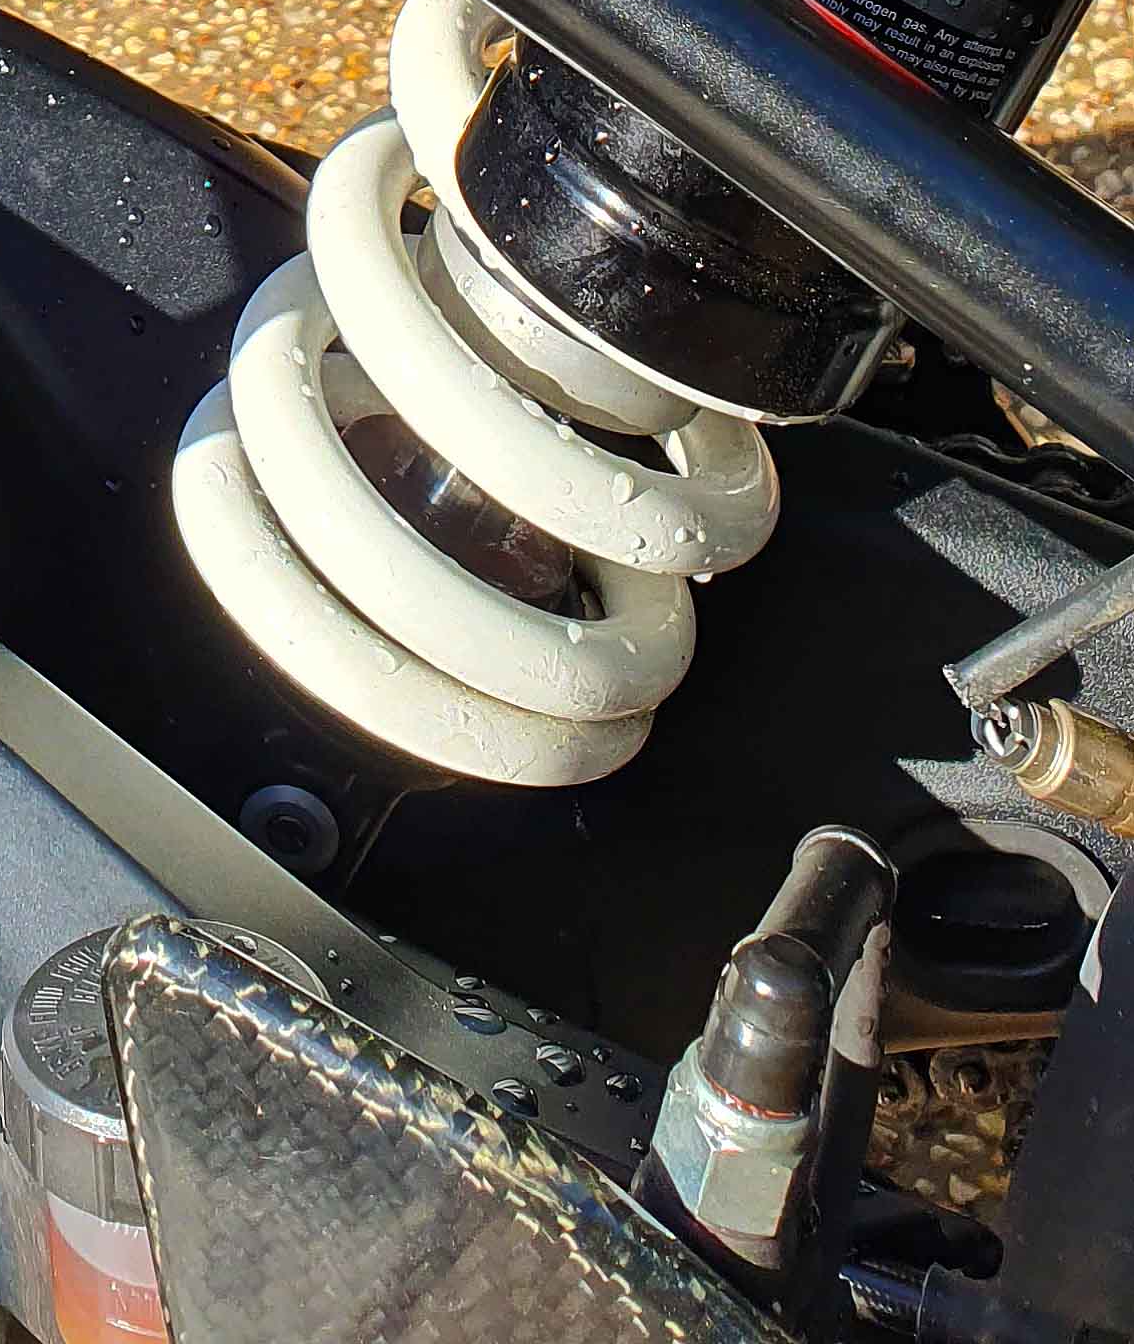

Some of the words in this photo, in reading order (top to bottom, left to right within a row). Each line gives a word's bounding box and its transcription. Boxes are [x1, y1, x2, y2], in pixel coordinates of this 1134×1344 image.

[853, 11, 882, 32] may
[884, 26, 922, 48] result
[923, 41, 936, 54] in
[938, 48, 955, 61] an
[933, 28, 960, 47] Any
[962, 39, 1004, 58] attempt
[896, 49, 923, 68] may
[923, 58, 948, 74] also
